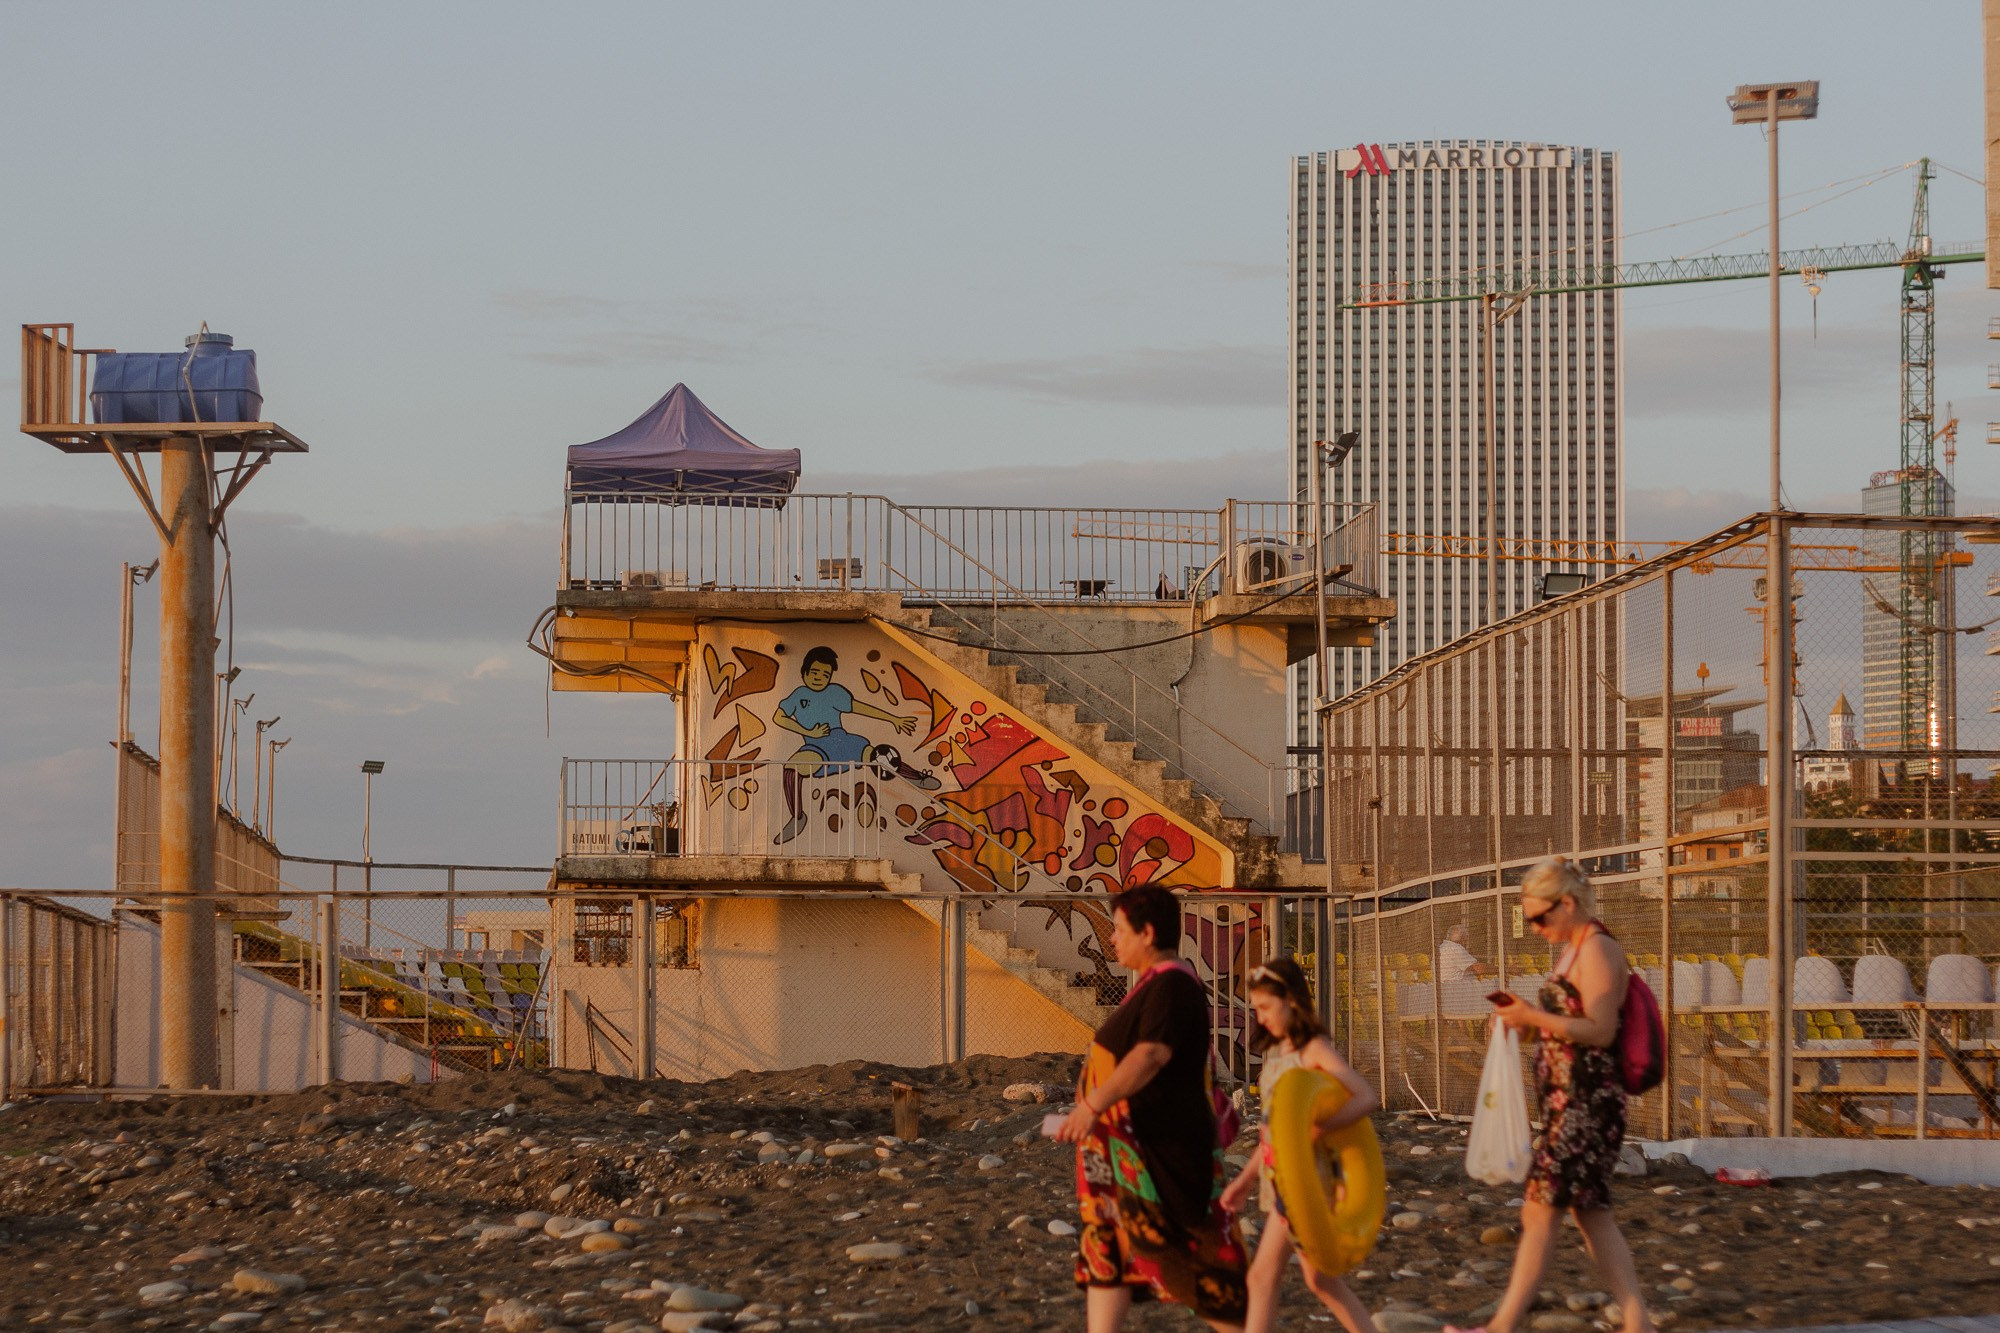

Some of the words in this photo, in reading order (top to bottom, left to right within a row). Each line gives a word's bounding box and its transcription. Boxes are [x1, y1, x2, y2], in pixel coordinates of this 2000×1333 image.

[1398, 147, 1565, 168] MARRIOTT
[1680, 717, 1697, 728] FOR
[1699, 717, 1721, 728] SALE
[572, 833, 610, 845] BATUMI
